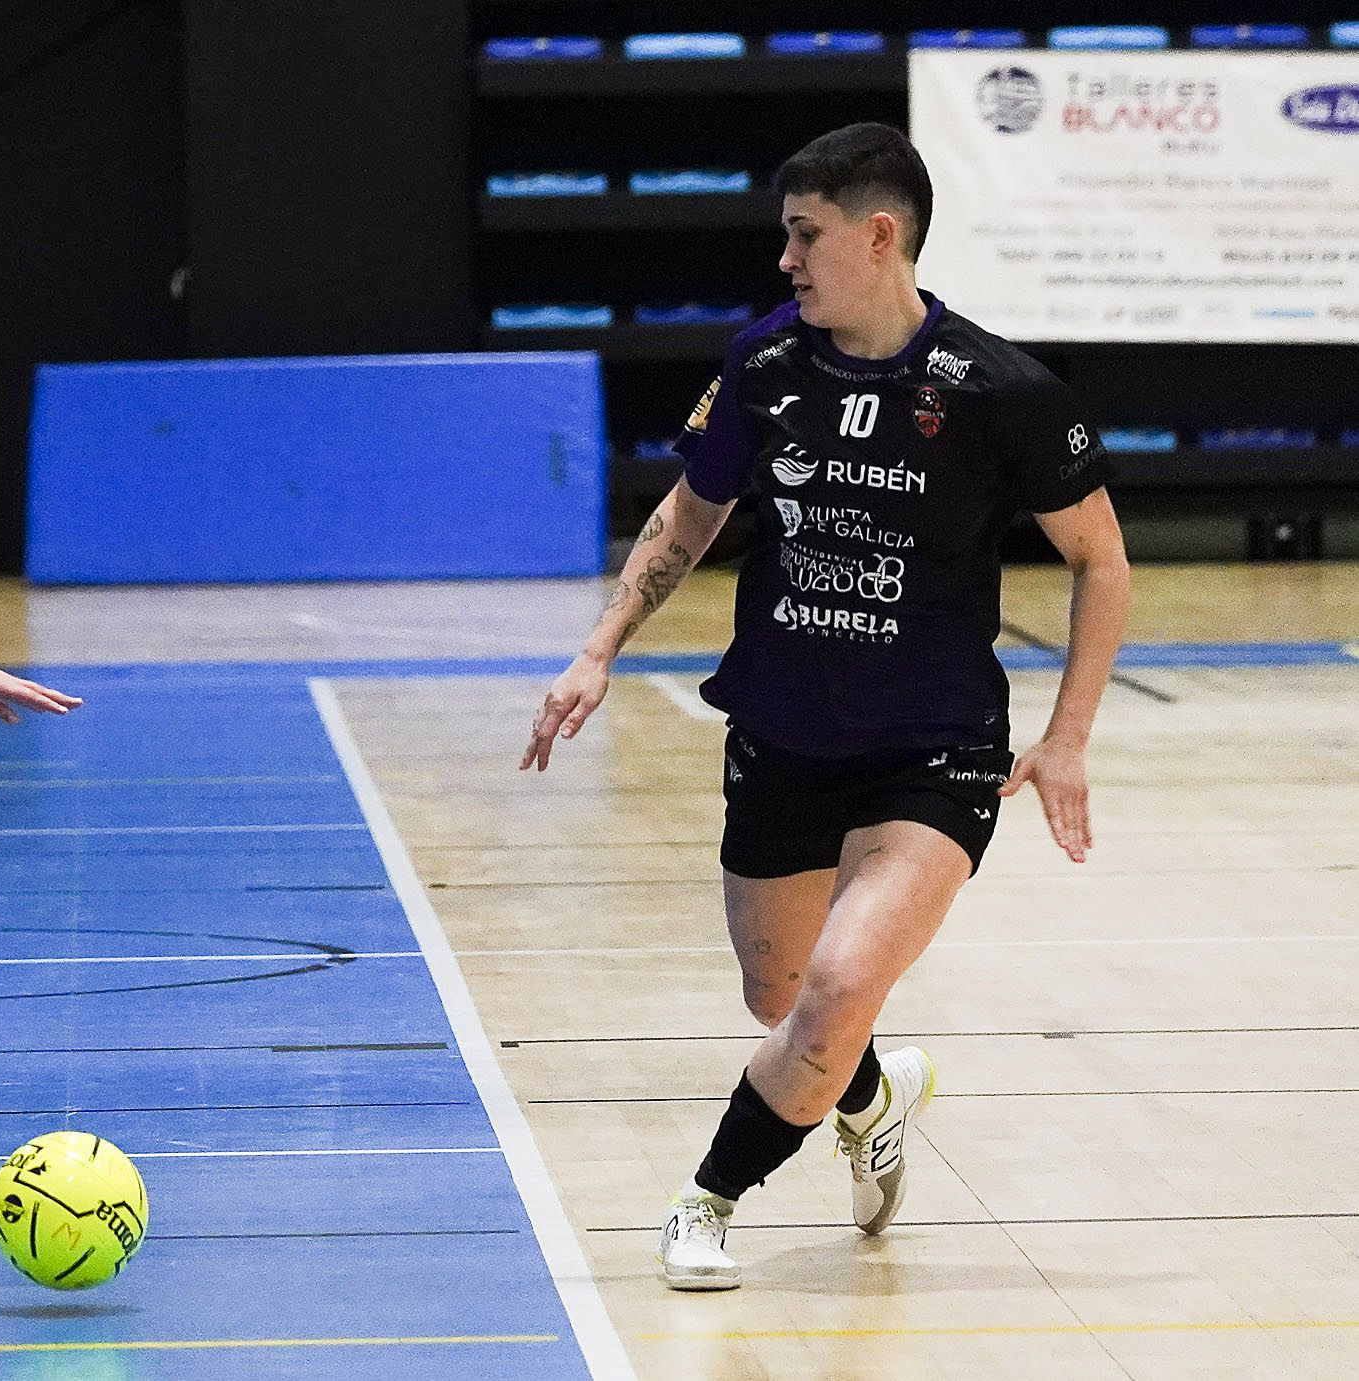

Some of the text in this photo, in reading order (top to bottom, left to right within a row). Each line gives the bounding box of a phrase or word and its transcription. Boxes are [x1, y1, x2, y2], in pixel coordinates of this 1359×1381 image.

[839, 393, 879, 438] 10
[826, 460, 926, 495] RUBÉN
[806, 505, 873, 524] XUNTA
[803, 521, 915, 548] E GALICIA
[798, 603, 899, 635] BURELA
[806, 627, 893, 644] ONCELLO
[95, 1200, 138, 1252] oma
